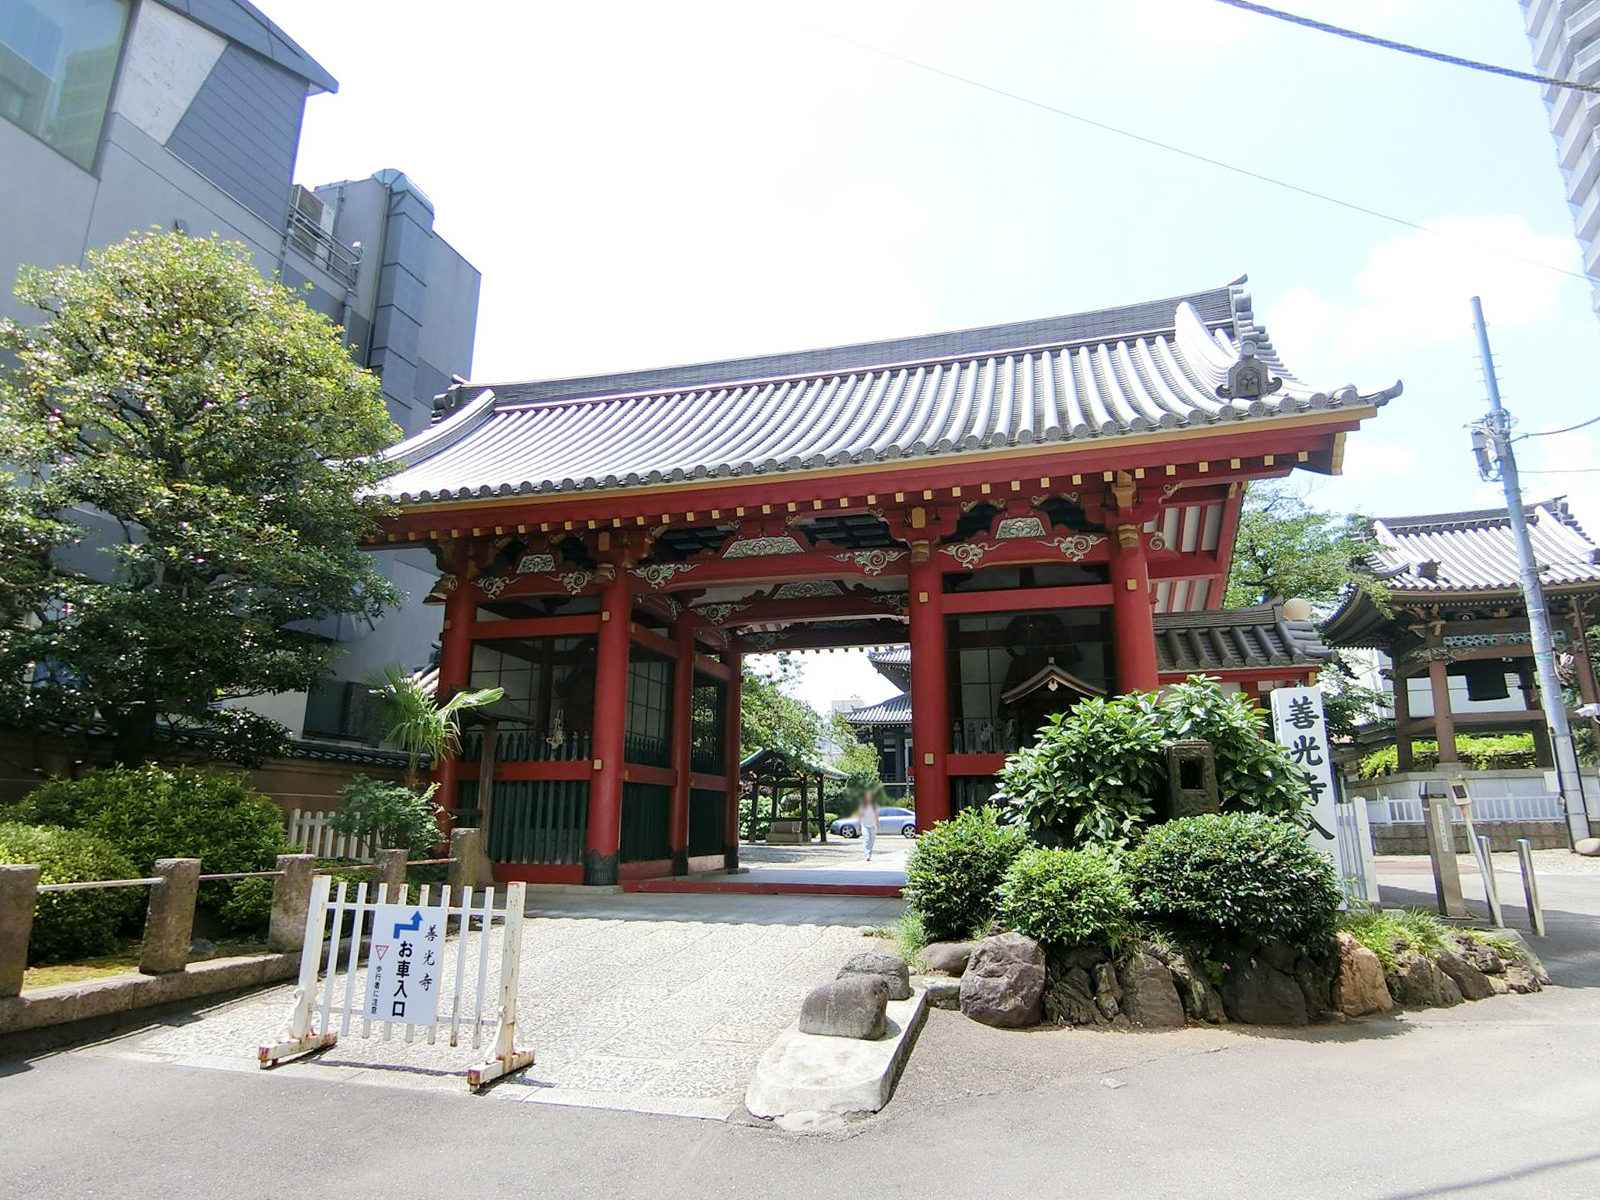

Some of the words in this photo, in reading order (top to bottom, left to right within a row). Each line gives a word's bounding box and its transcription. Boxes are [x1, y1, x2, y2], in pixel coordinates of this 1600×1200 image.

[392, 940, 413, 1017] お車入口
[419, 924, 438, 991] 善光寺
